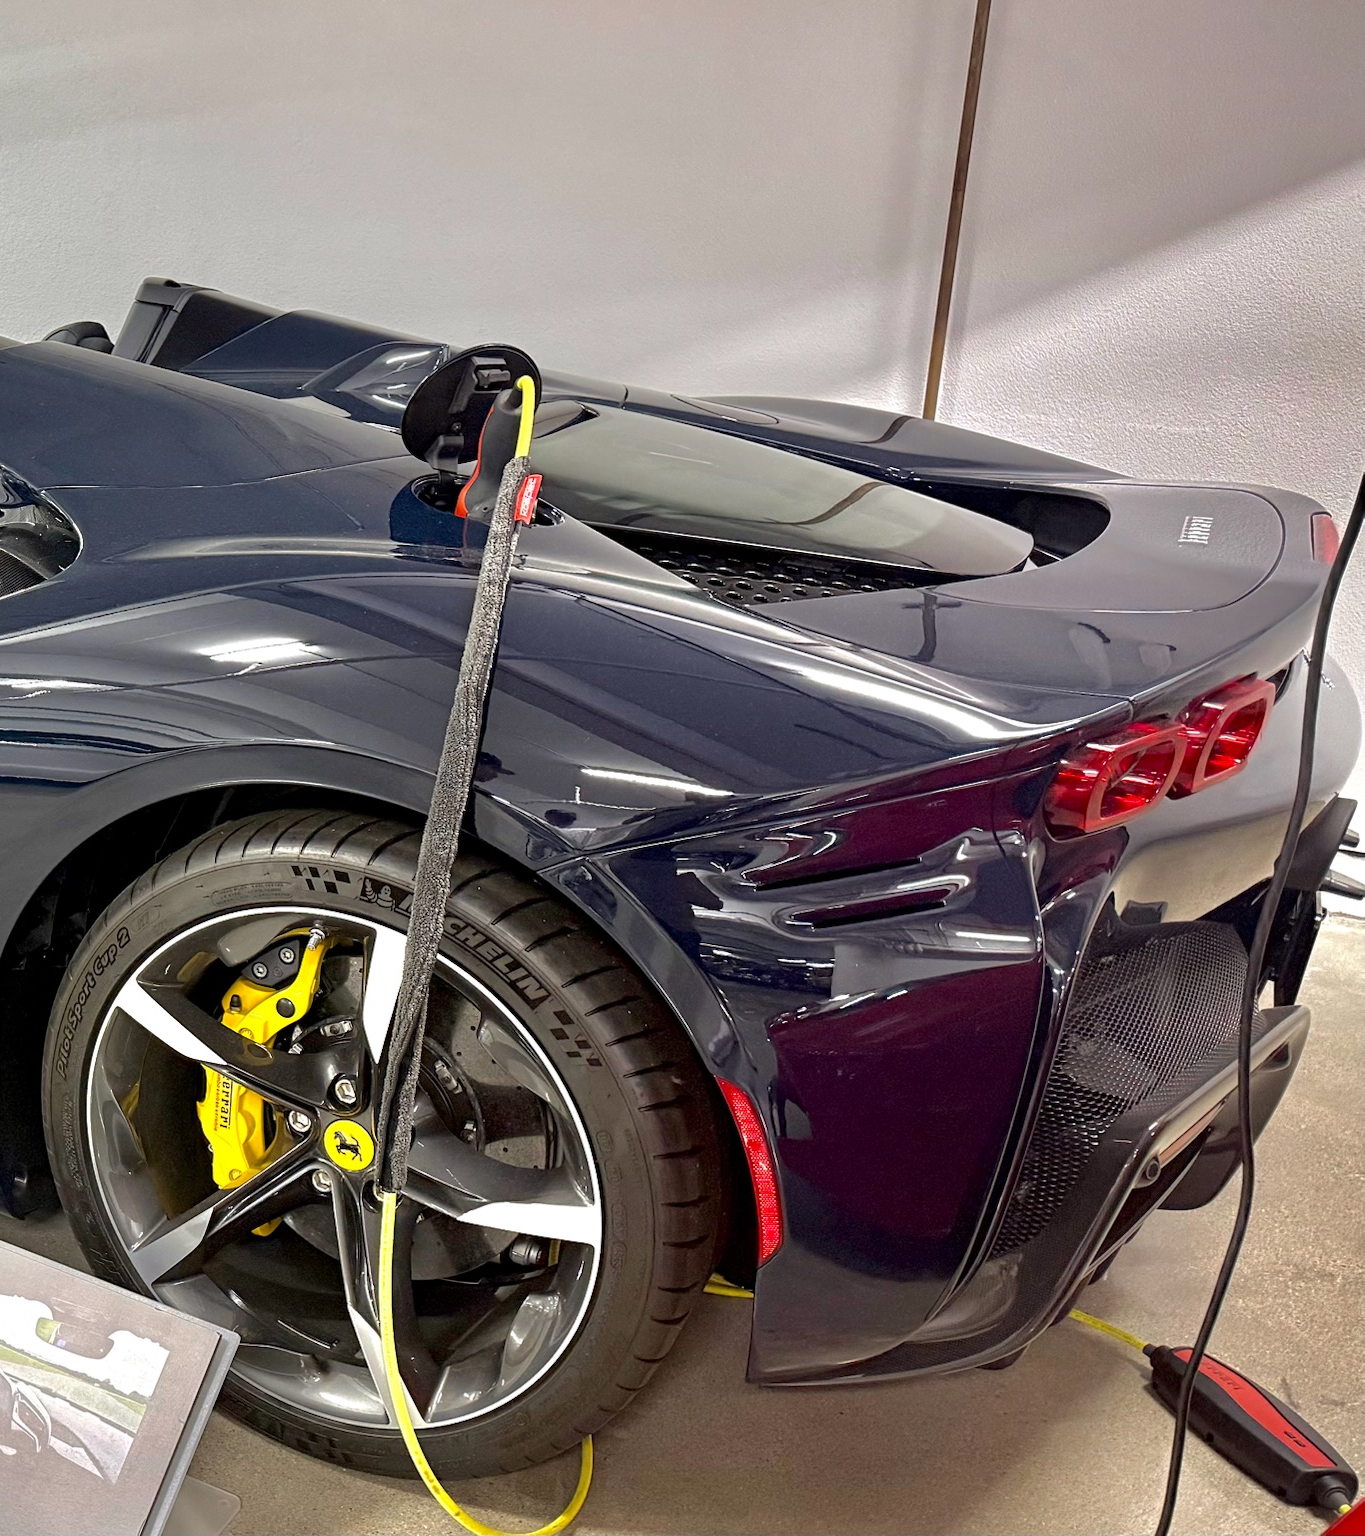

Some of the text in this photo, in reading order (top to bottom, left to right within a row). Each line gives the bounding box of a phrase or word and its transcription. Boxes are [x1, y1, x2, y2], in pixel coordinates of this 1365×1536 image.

[397, 895, 550, 1002] MCHELIN
[56, 1026, 75, 1080] Pilot
[67, 971, 96, 1032] Sport
[92, 944, 119, 977] Cup
[116, 926, 131, 949] 2
[219, 1076, 234, 1130] errari
